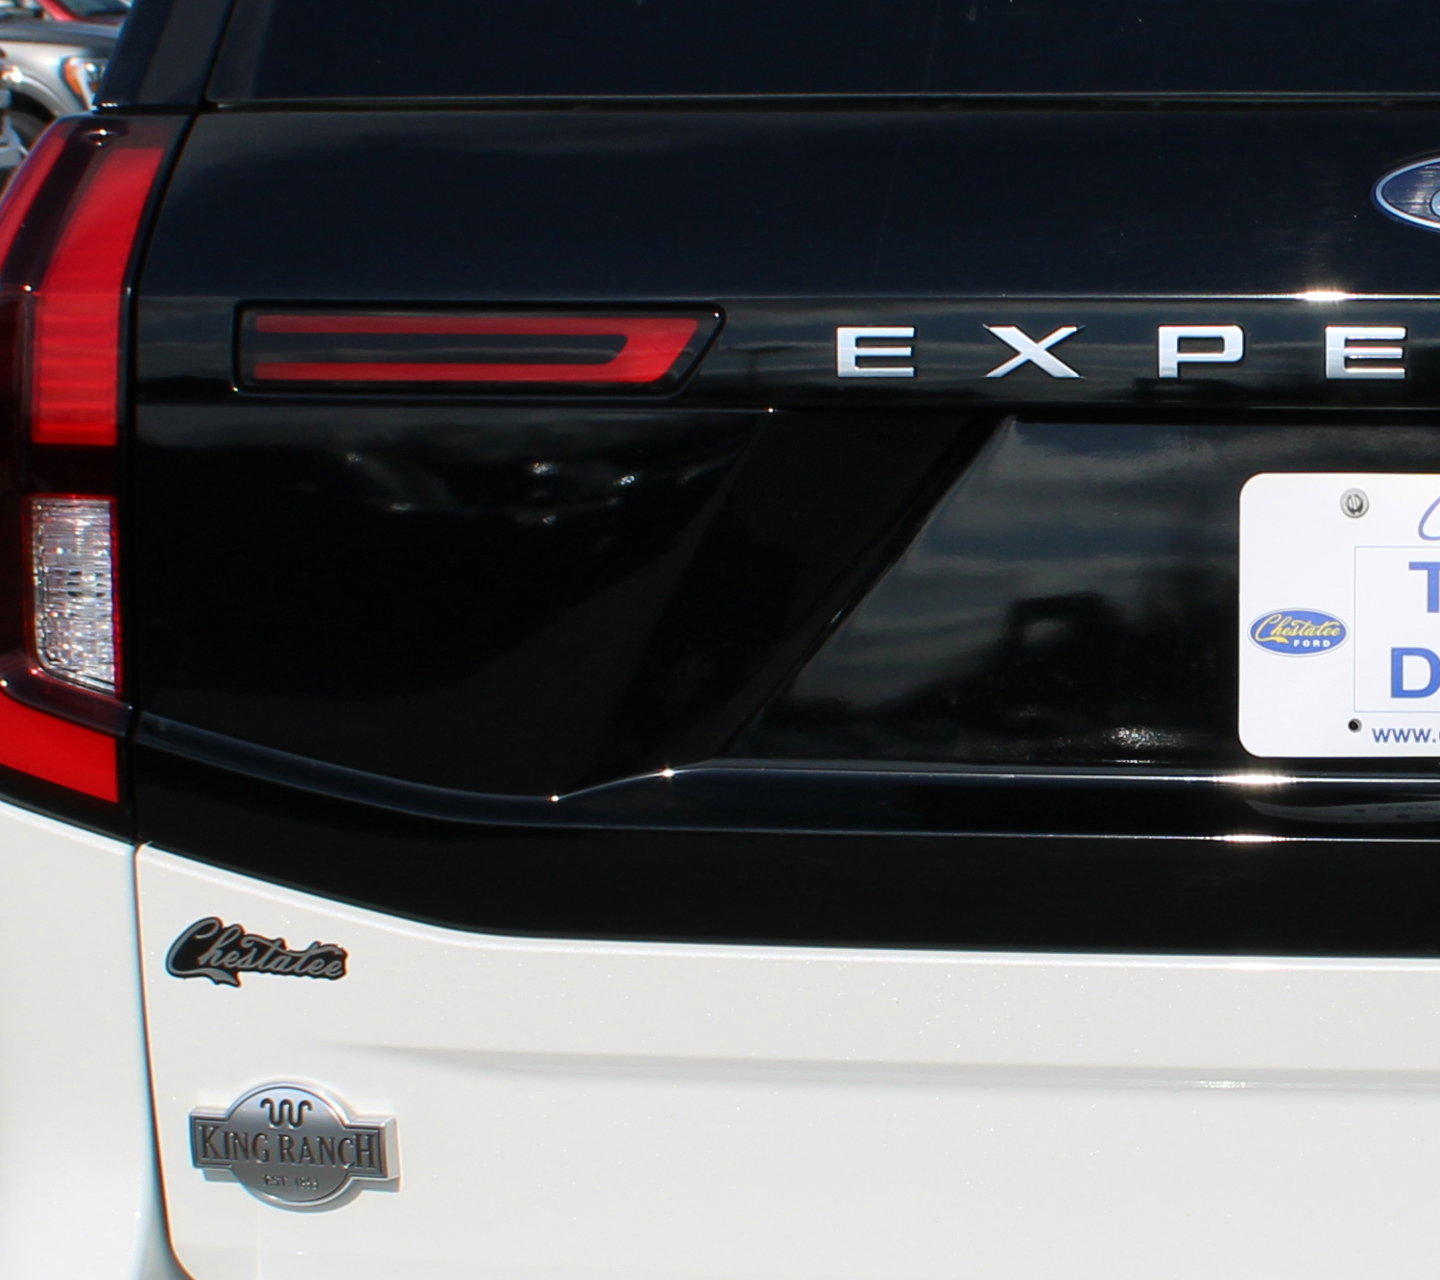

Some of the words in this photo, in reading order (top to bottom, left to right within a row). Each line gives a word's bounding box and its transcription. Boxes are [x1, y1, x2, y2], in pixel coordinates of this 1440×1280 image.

[1255, 613, 1341, 644] Chestatee
[1293, 639, 1331, 648] FORD
[167, 917, 347, 987] Chestatee
[198, 1124, 271, 1164] KING
[277, 1133, 377, 1169] RANCH
